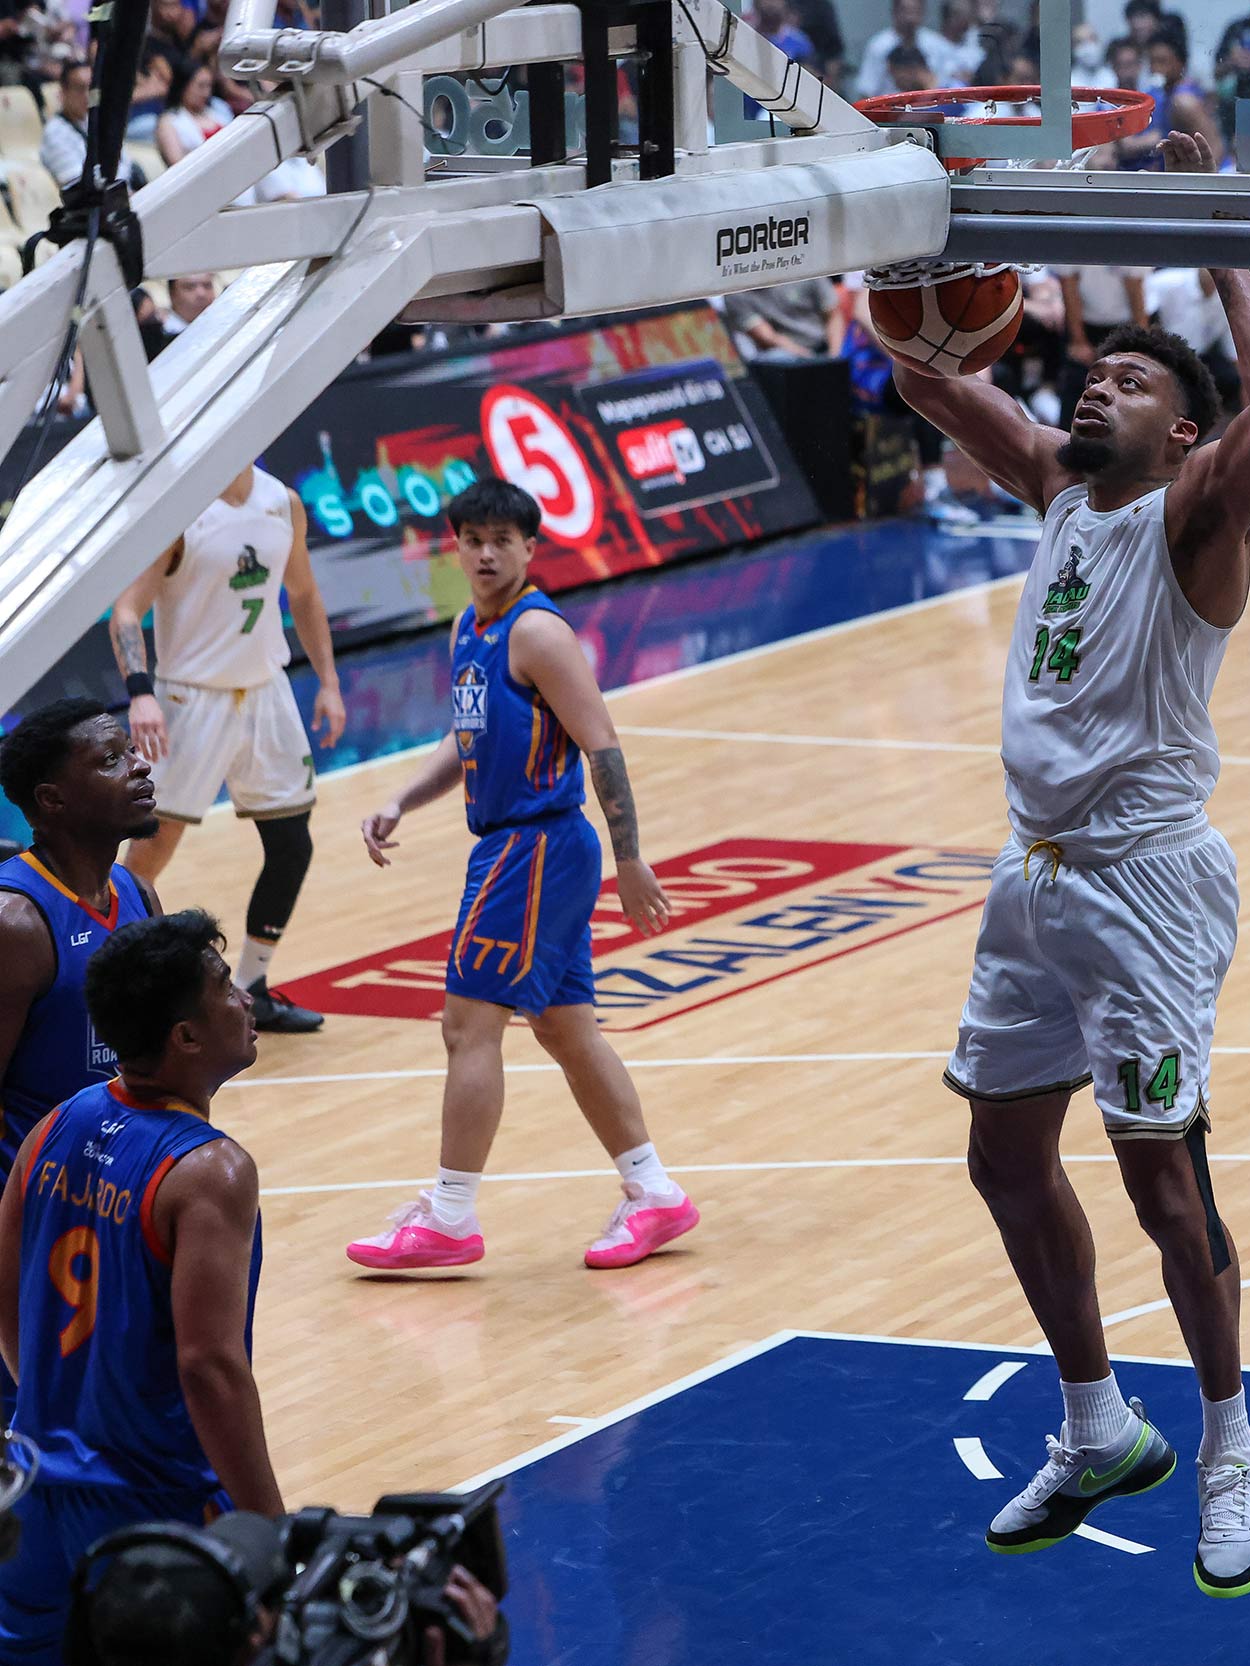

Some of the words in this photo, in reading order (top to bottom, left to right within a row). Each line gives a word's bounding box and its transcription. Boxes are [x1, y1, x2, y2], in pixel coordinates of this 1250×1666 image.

[240, 597, 265, 635] 7
[1028, 624, 1085, 686] 14
[472, 935, 520, 975] 77
[1116, 1046, 1183, 1114] 14
[48, 1225, 100, 1359] 9
